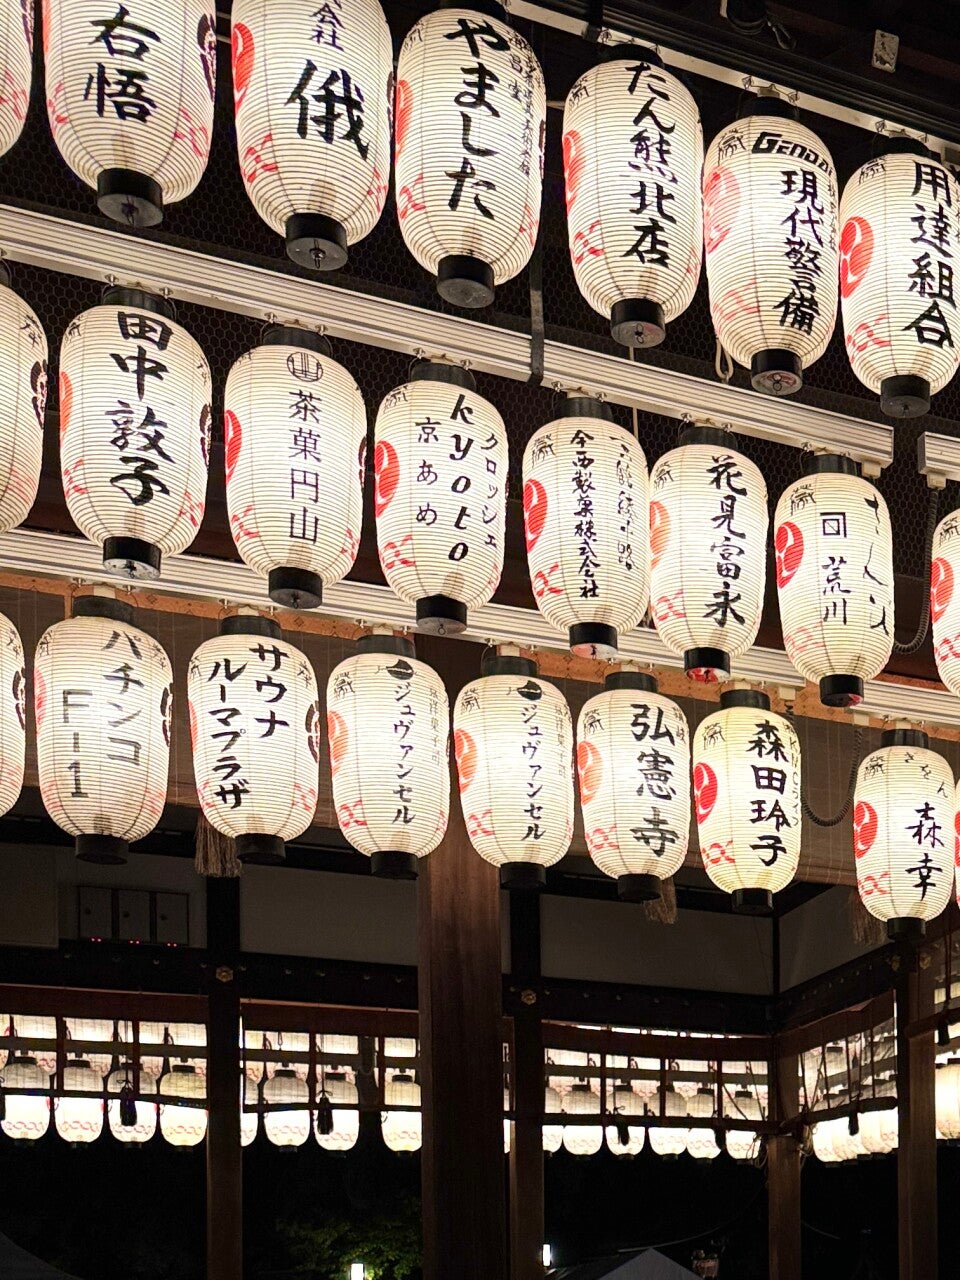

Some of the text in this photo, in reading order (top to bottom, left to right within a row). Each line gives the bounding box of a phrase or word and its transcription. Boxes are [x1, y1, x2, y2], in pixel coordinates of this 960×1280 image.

[312, 0, 345, 52] 会社
[284, 59, 370, 160] 俄
[443, 17, 511, 221] やました
[623, 61, 679, 269] たん熊北店
[773, 168, 824, 336] 現代警備
[901, 160, 957, 351] 用達組合
[104, 310, 176, 507] 田中敦子
[287, 388, 323, 546] 茶菓円山
[414, 416, 442, 526] 京あめ
[100, 630, 145, 766] パチンコ
[206, 657, 251, 810] ルーマプラザ
[248, 642, 291, 739] サウナ
[391, 683, 418, 826] ジュヴァンセル
[520, 703, 547, 842] ジュヴァンセル
[628, 703, 681, 858] 弘憲寺
[745, 719, 792, 867] 森田玲子
[904, 801, 946, 902] 森幸
